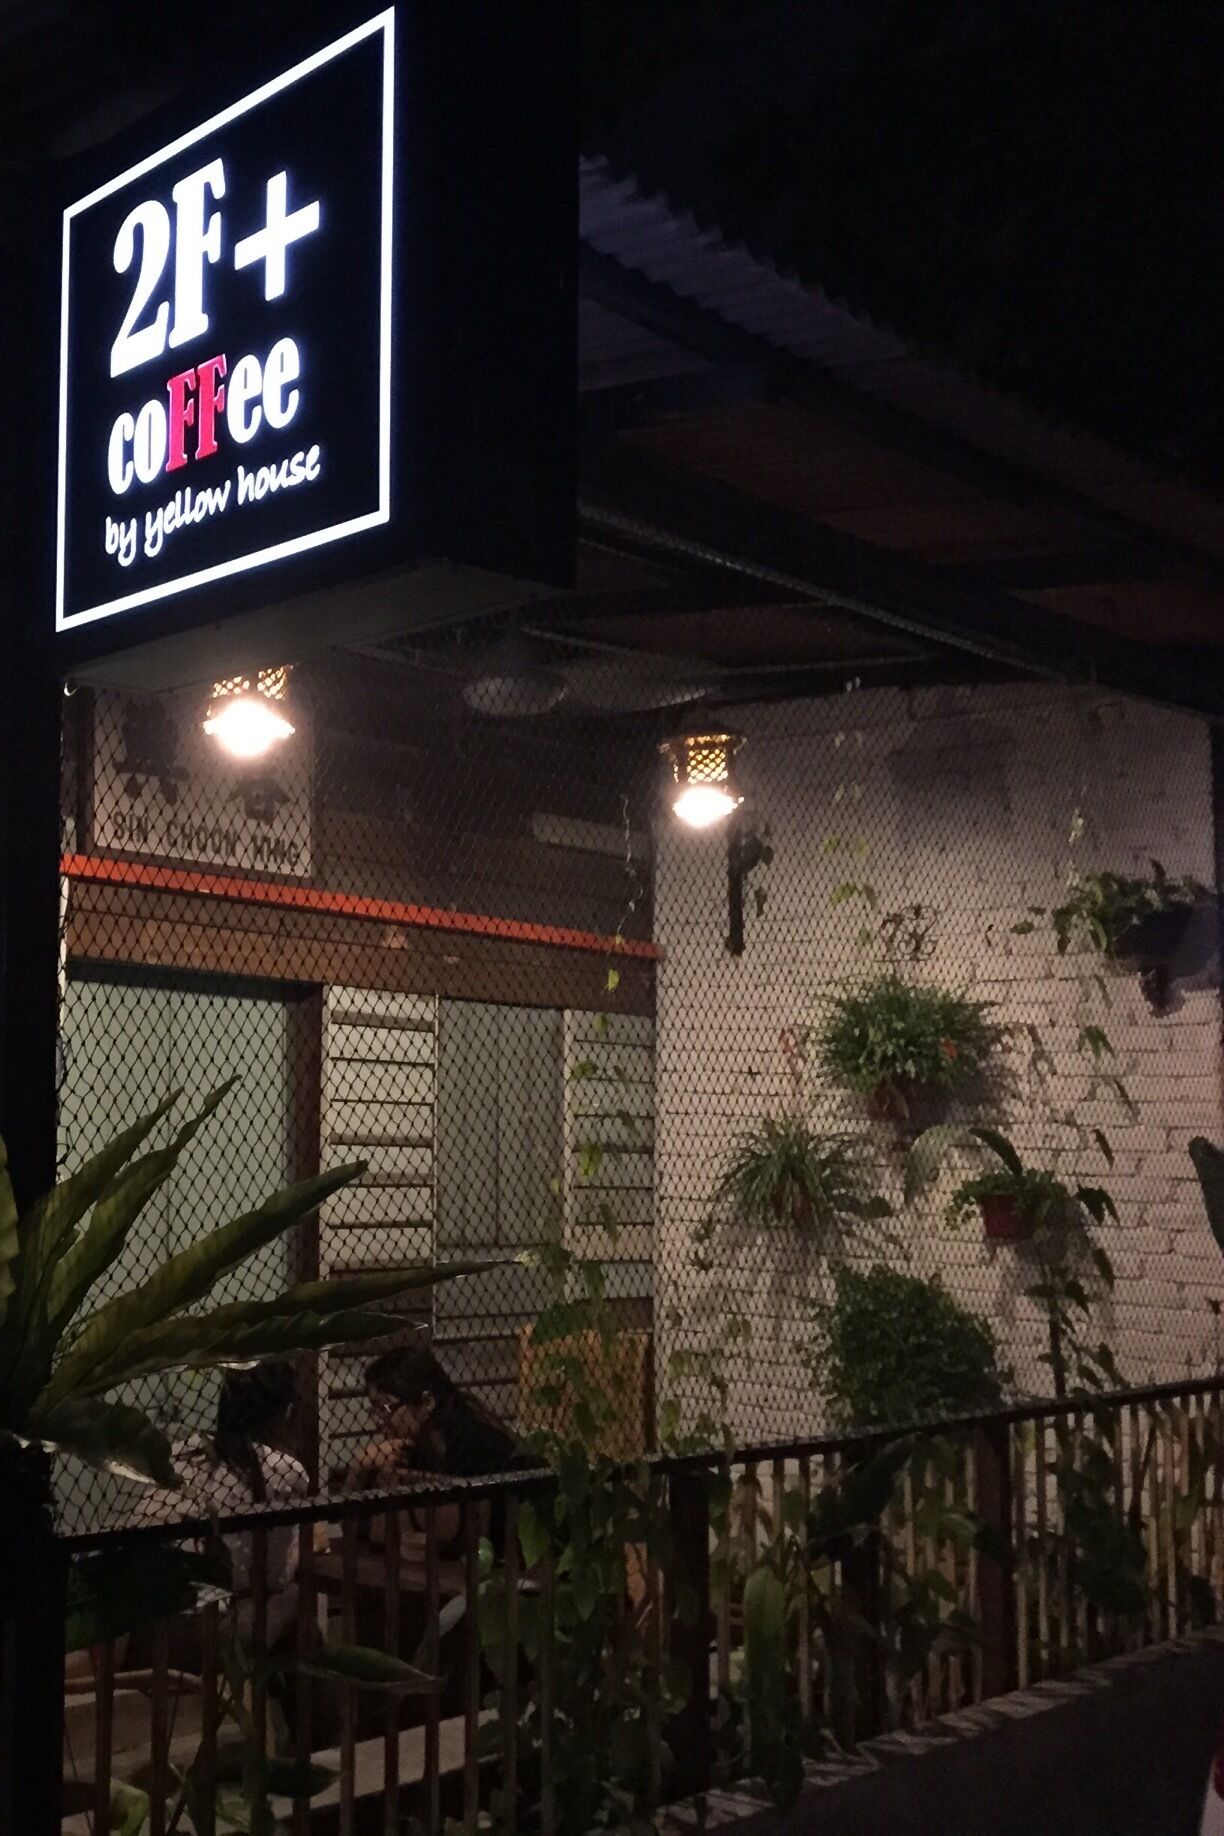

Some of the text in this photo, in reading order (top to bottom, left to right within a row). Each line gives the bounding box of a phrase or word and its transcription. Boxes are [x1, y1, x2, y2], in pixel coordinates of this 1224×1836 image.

[105, 444, 321, 567] by yellow house
[113, 811, 149, 843] SIN
[166, 818, 236, 857] CHOON
